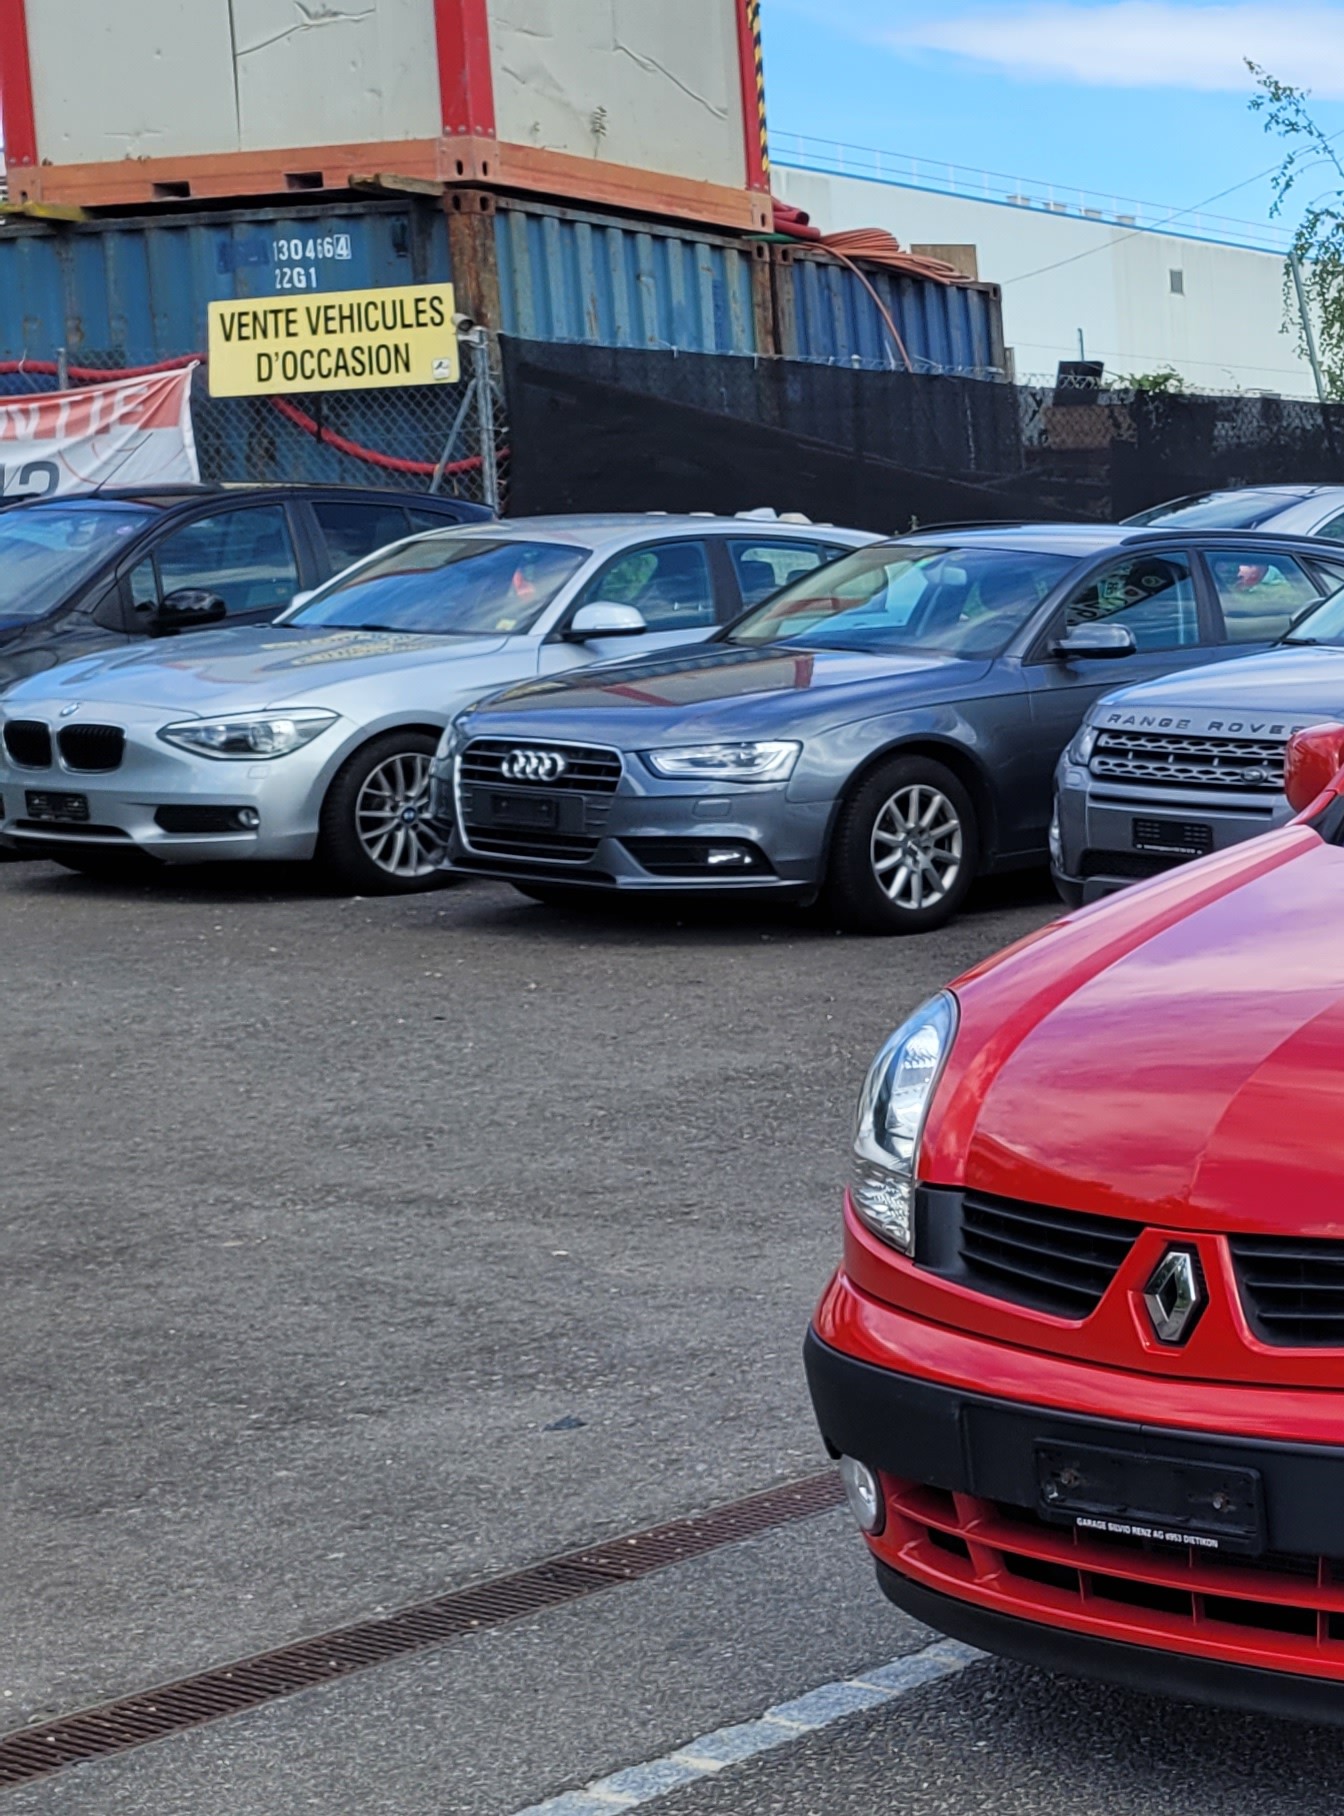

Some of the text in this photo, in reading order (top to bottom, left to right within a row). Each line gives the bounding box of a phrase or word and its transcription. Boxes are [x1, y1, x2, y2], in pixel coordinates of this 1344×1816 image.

[275, 267, 317, 289] 22G1
[220, 296, 444, 342] VENTE VEHICULES
[257, 343, 410, 383] D'OCCASION
[1107, 713, 1192, 730] RANGE
[1076, 1517, 1106, 1530] GARAGE
[1132, 1526, 1152, 1537] RENZ
[1153, 1530, 1164, 1539] AG
[1183, 1535, 1219, 1548] DIETIKON
